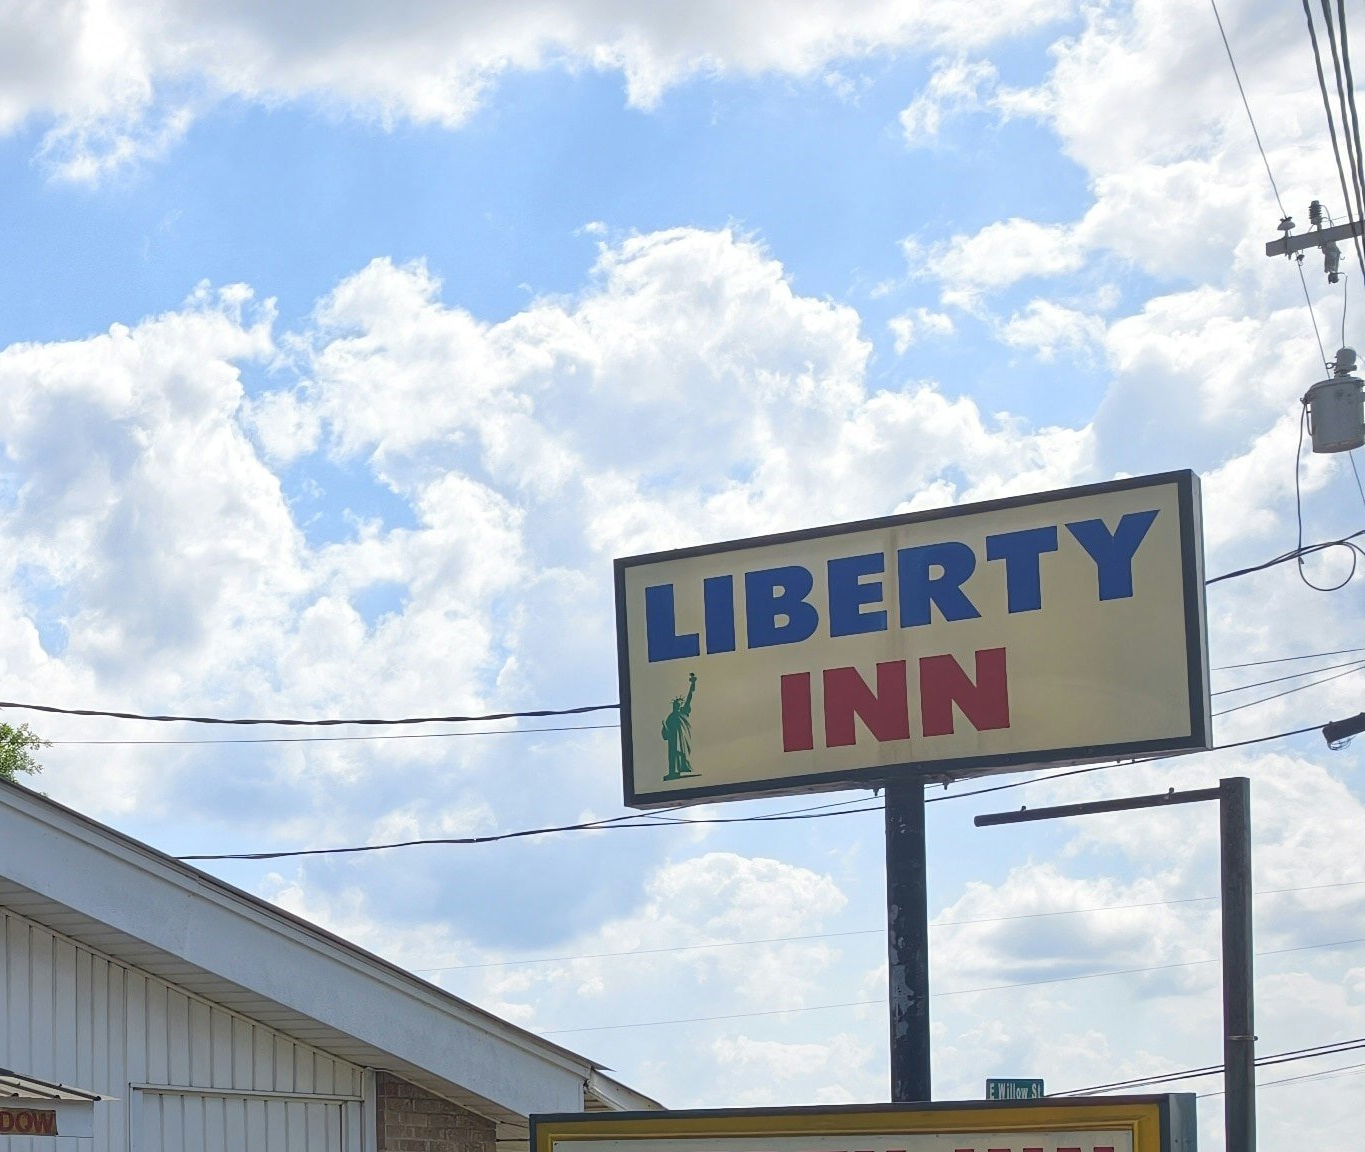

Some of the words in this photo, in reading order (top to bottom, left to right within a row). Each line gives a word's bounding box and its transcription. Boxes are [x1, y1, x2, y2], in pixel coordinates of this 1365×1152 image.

[644, 508, 1160, 663] LIBERTY
[781, 647, 1011, 753] INN
[999, 1083, 1028, 1100] Willow
